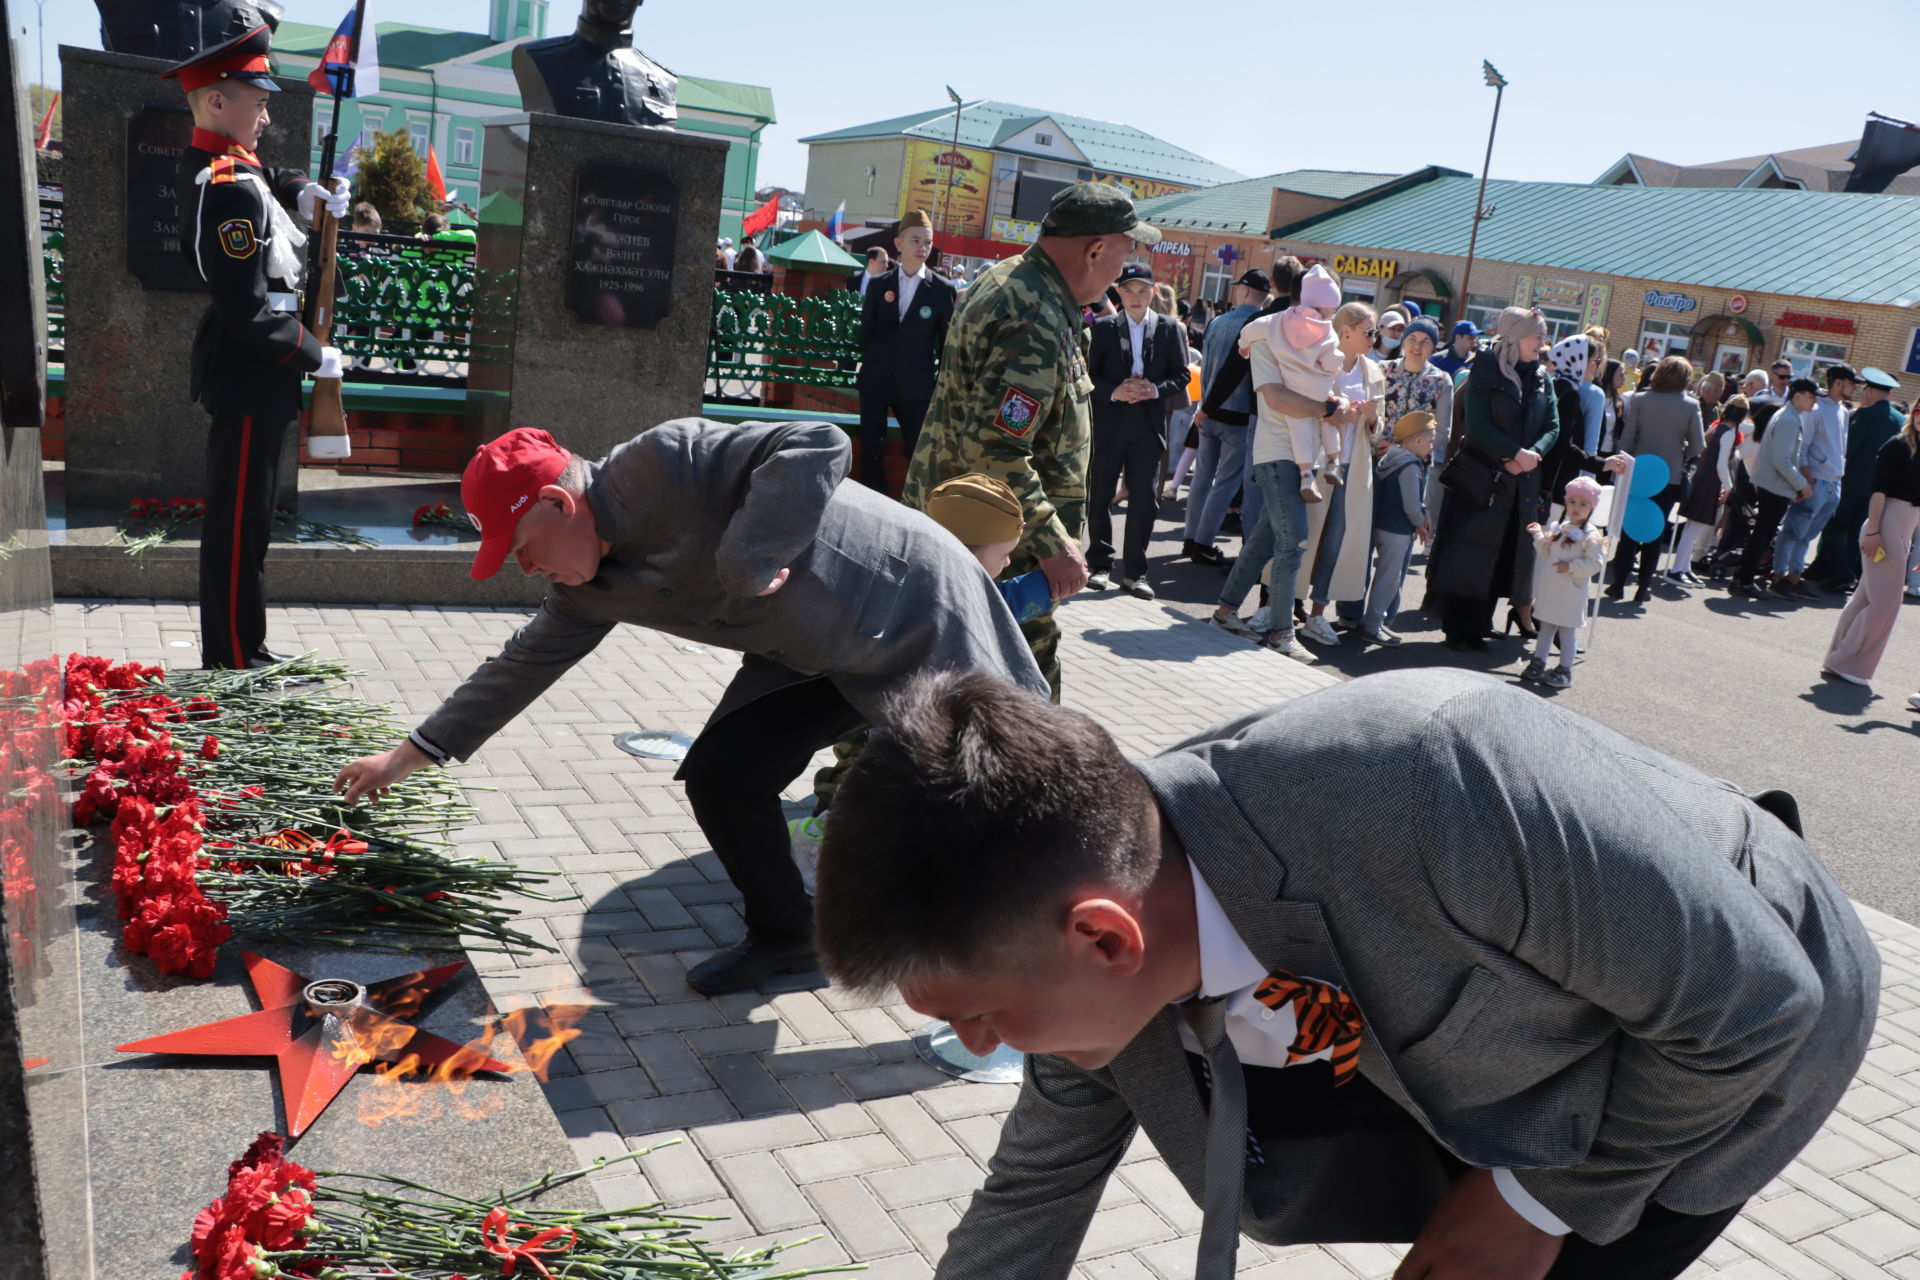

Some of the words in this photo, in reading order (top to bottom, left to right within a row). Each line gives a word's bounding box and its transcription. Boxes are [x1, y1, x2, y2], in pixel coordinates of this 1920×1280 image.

[1152, 241, 1191, 256] АПРЕЛЬ
[1333, 254, 1396, 279] САБАН
[510, 495, 529, 512] Audi
